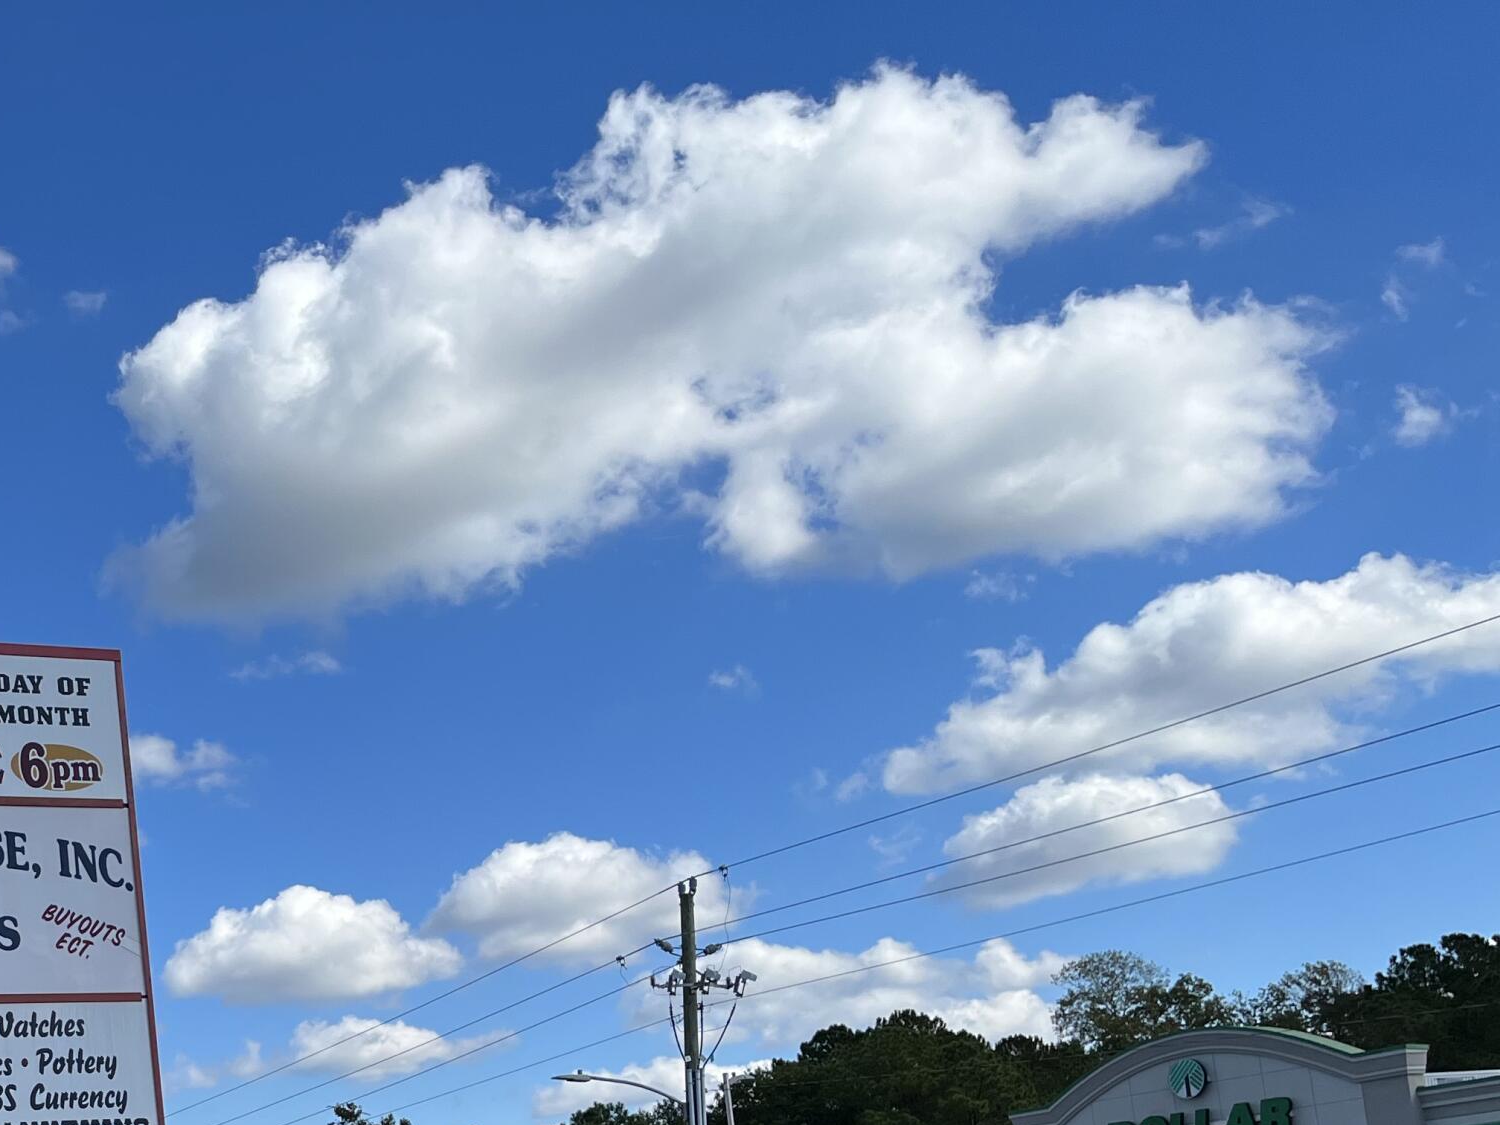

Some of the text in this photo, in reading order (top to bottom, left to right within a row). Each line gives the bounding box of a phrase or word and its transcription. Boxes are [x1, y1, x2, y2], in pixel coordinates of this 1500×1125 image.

[57, 677, 91, 696] OF
[20, 741, 101, 789] 6pm
[56, 838, 134, 892] INC.
[41, 904, 126, 947] BUYOUTS
[55, 932, 95, 959] ECT.
[36, 1048, 117, 1080] Pottery
[29, 1082, 128, 1114] Currency
